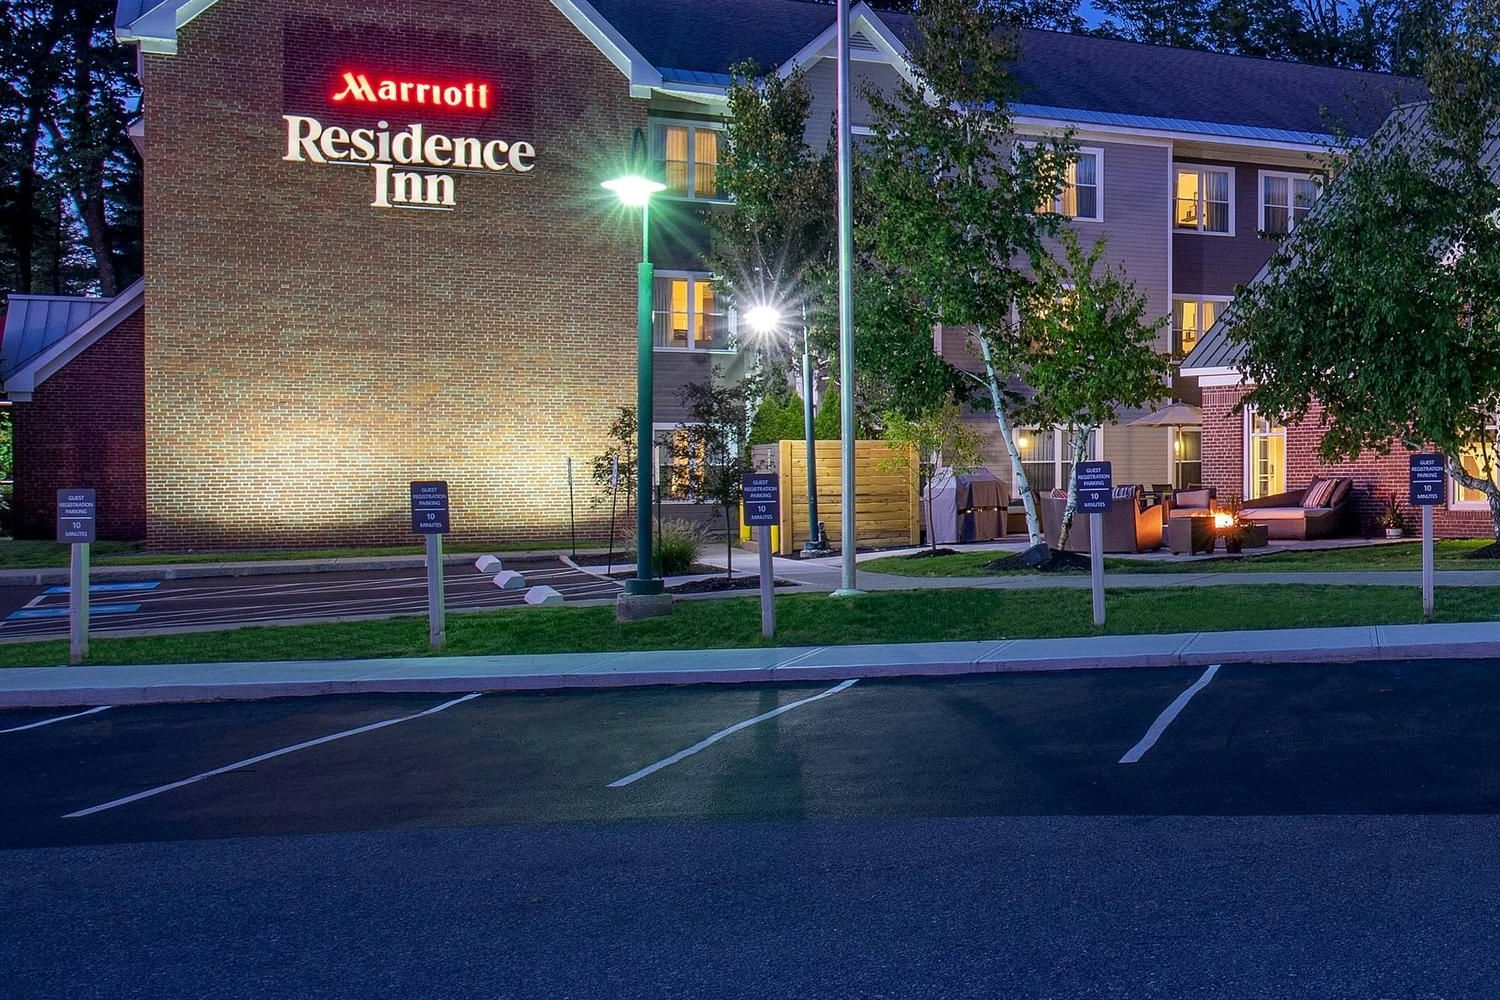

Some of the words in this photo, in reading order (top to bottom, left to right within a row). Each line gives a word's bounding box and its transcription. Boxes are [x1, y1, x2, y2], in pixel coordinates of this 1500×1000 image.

[332, 72, 488, 109] Marriott
[282, 114, 536, 173] Residence
[370, 163, 456, 208] Inn
